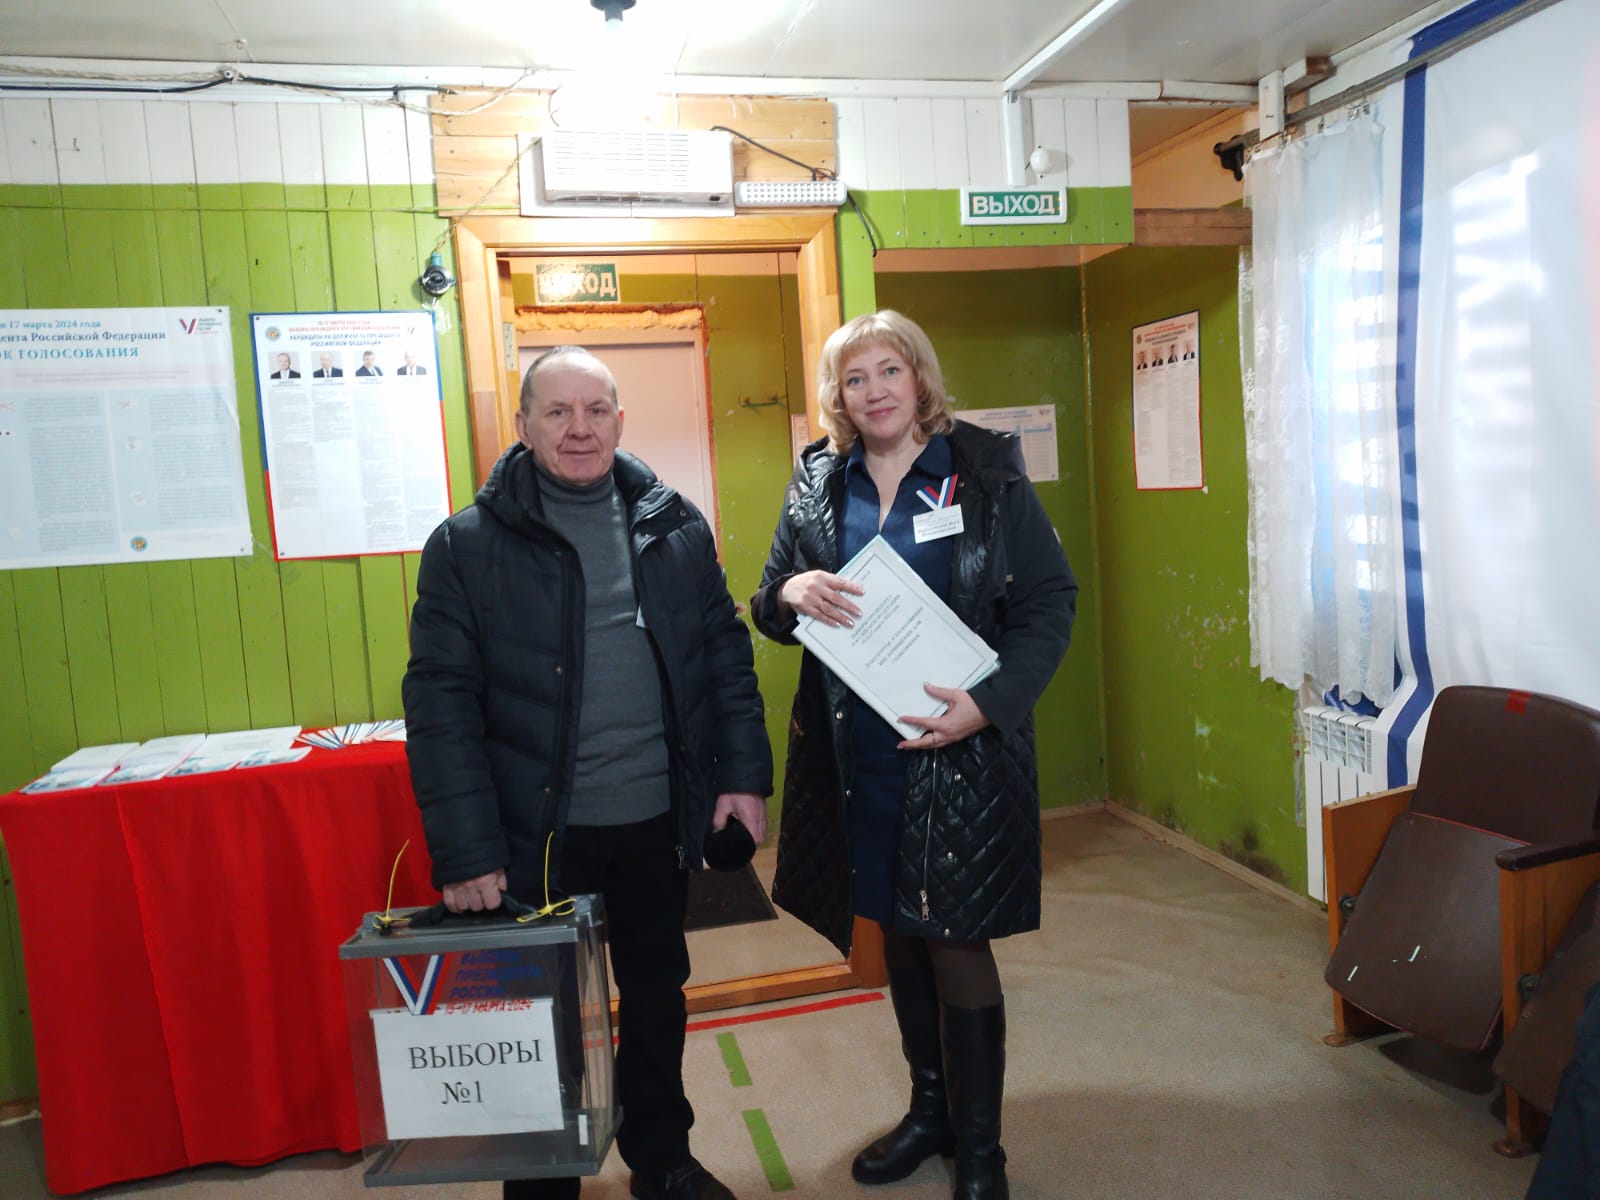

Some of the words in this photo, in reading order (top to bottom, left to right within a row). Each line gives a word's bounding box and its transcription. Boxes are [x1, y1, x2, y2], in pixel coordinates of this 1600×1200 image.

[972, 194, 1056, 215] ВЫХОД
[9, 320, 20, 329] 17
[23, 321, 53, 330] марта
[55, 320, 78, 329] 2024
[80, 320, 102, 329] года
[0, 333, 28, 342] ента
[31, 331, 99, 342] Российской
[102, 330, 166, 342] Федерации
[18, 346, 139, 360] ГОЛОСОВАНИЯ
[408, 1039, 543, 1070] ВЫБОРЫ
[442, 1080, 483, 1105] №1
